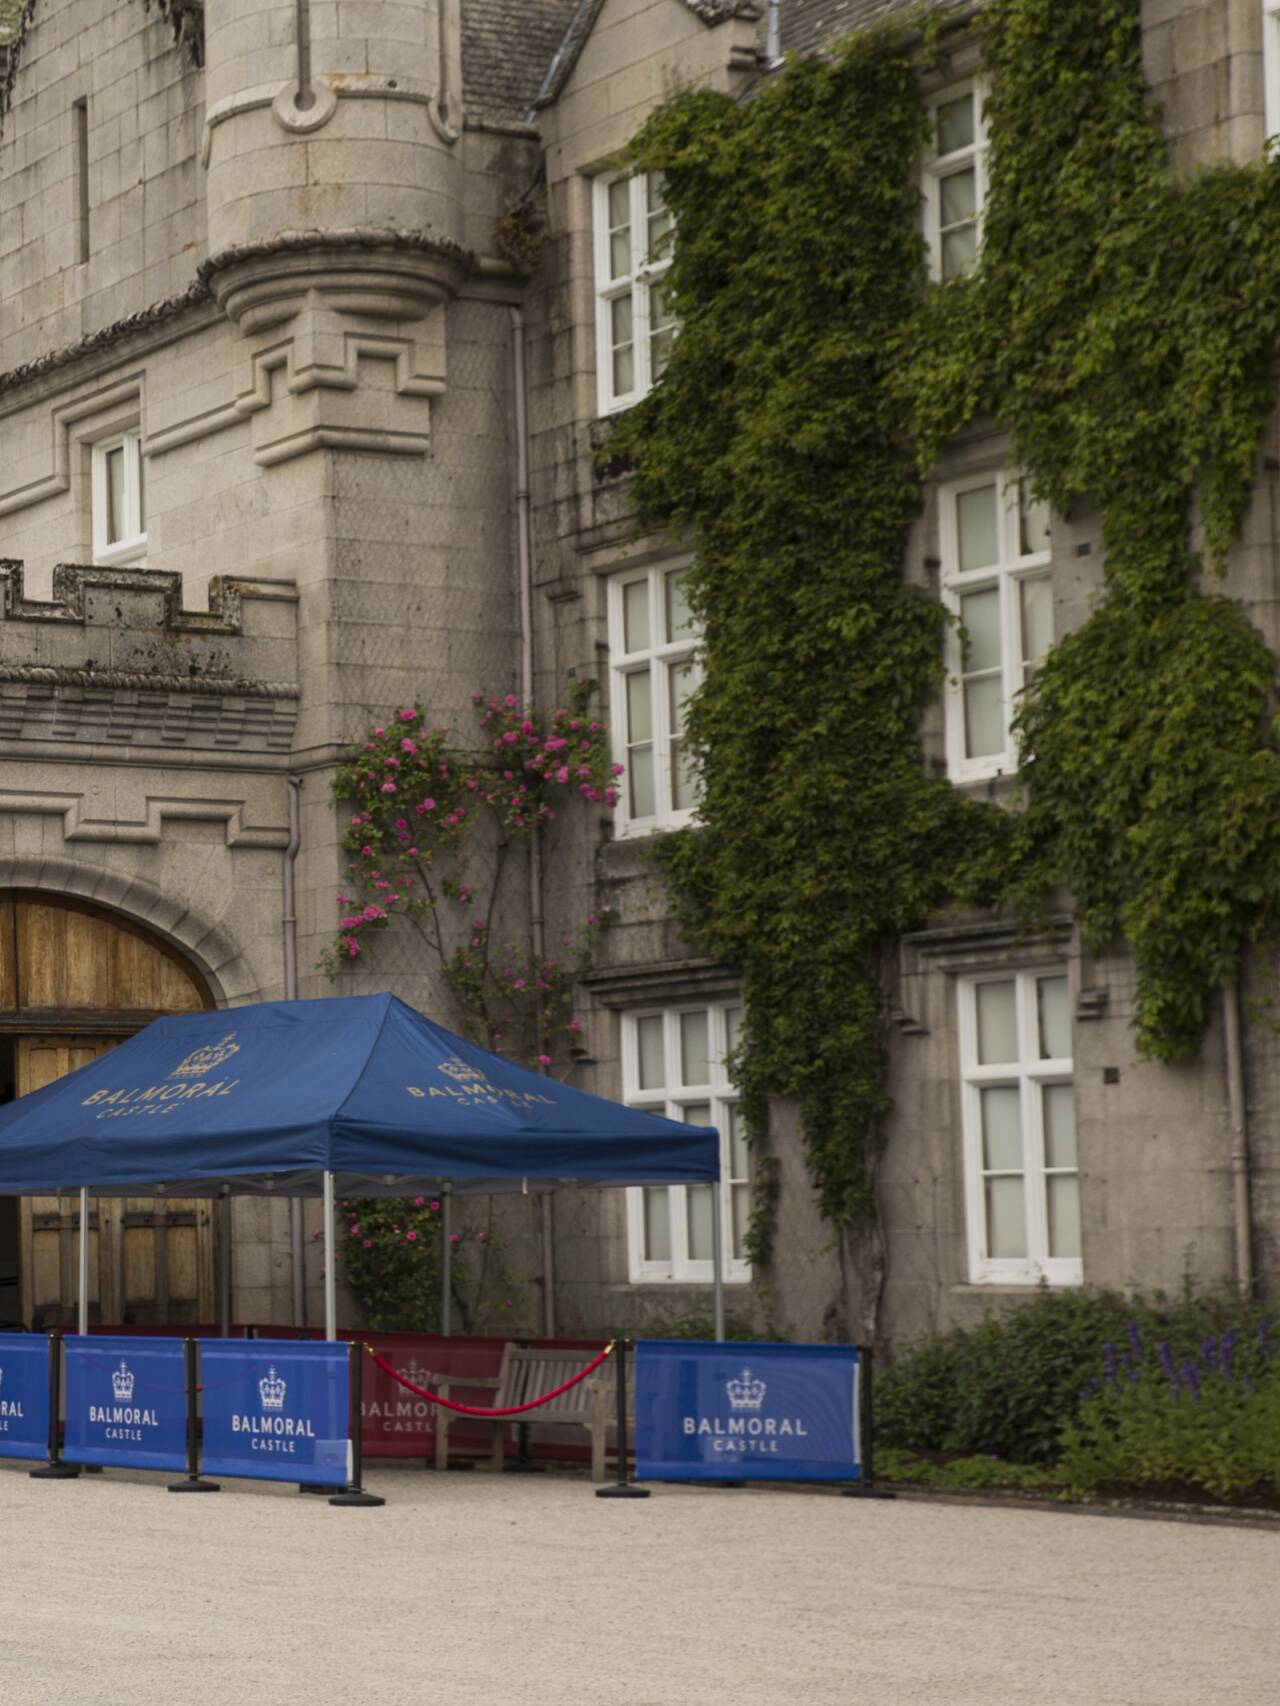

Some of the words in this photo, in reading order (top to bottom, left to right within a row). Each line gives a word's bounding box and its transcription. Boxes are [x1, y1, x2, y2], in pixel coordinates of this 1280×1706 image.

[81, 1079, 240, 1105] BALMORAL
[96, 1103, 182, 1119] CASTLE
[89, 1406, 159, 1426] BALMORAL
[232, 1414, 315, 1437] BALMORAL
[383, 1421, 433, 1432] CASTL
[683, 1417, 808, 1436] BALMORAL
[105, 1427, 142, 1441] CASTLE
[251, 1438, 295, 1453] CASTLE
[713, 1440, 779, 1452] CASTLE
